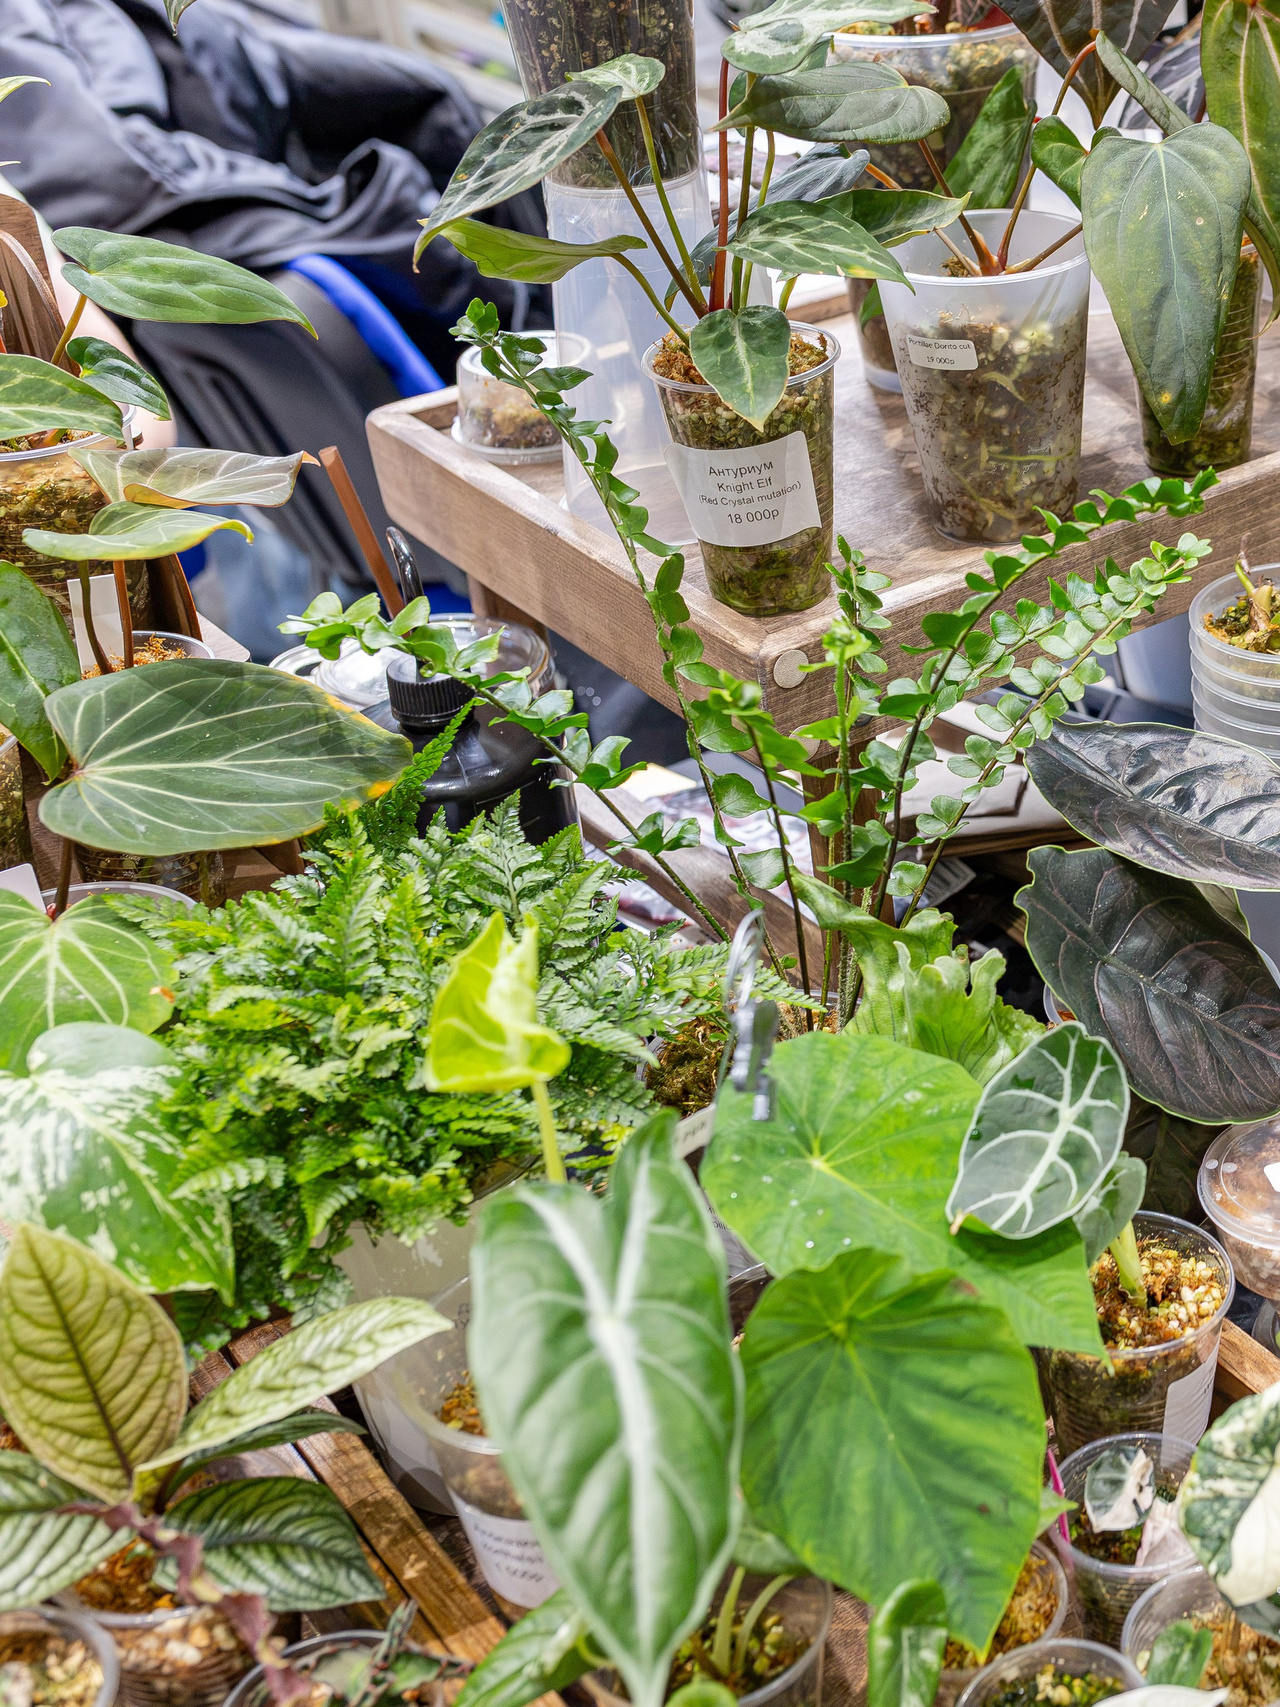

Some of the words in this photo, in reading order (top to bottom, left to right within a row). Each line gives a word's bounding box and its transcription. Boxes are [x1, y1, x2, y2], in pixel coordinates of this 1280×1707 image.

[934, 342, 958, 350] Dorito
[708, 461, 774, 479] Антуриум
[698, 494, 718, 506] (Red
[720, 495, 755, 508] Crystal
[757, 480, 802, 502] mutation)
[716, 481, 755, 494] Knight
[757, 476, 773, 489] Elf
[727, 513, 743, 524] 18
[745, 508, 780, 523] 000р
